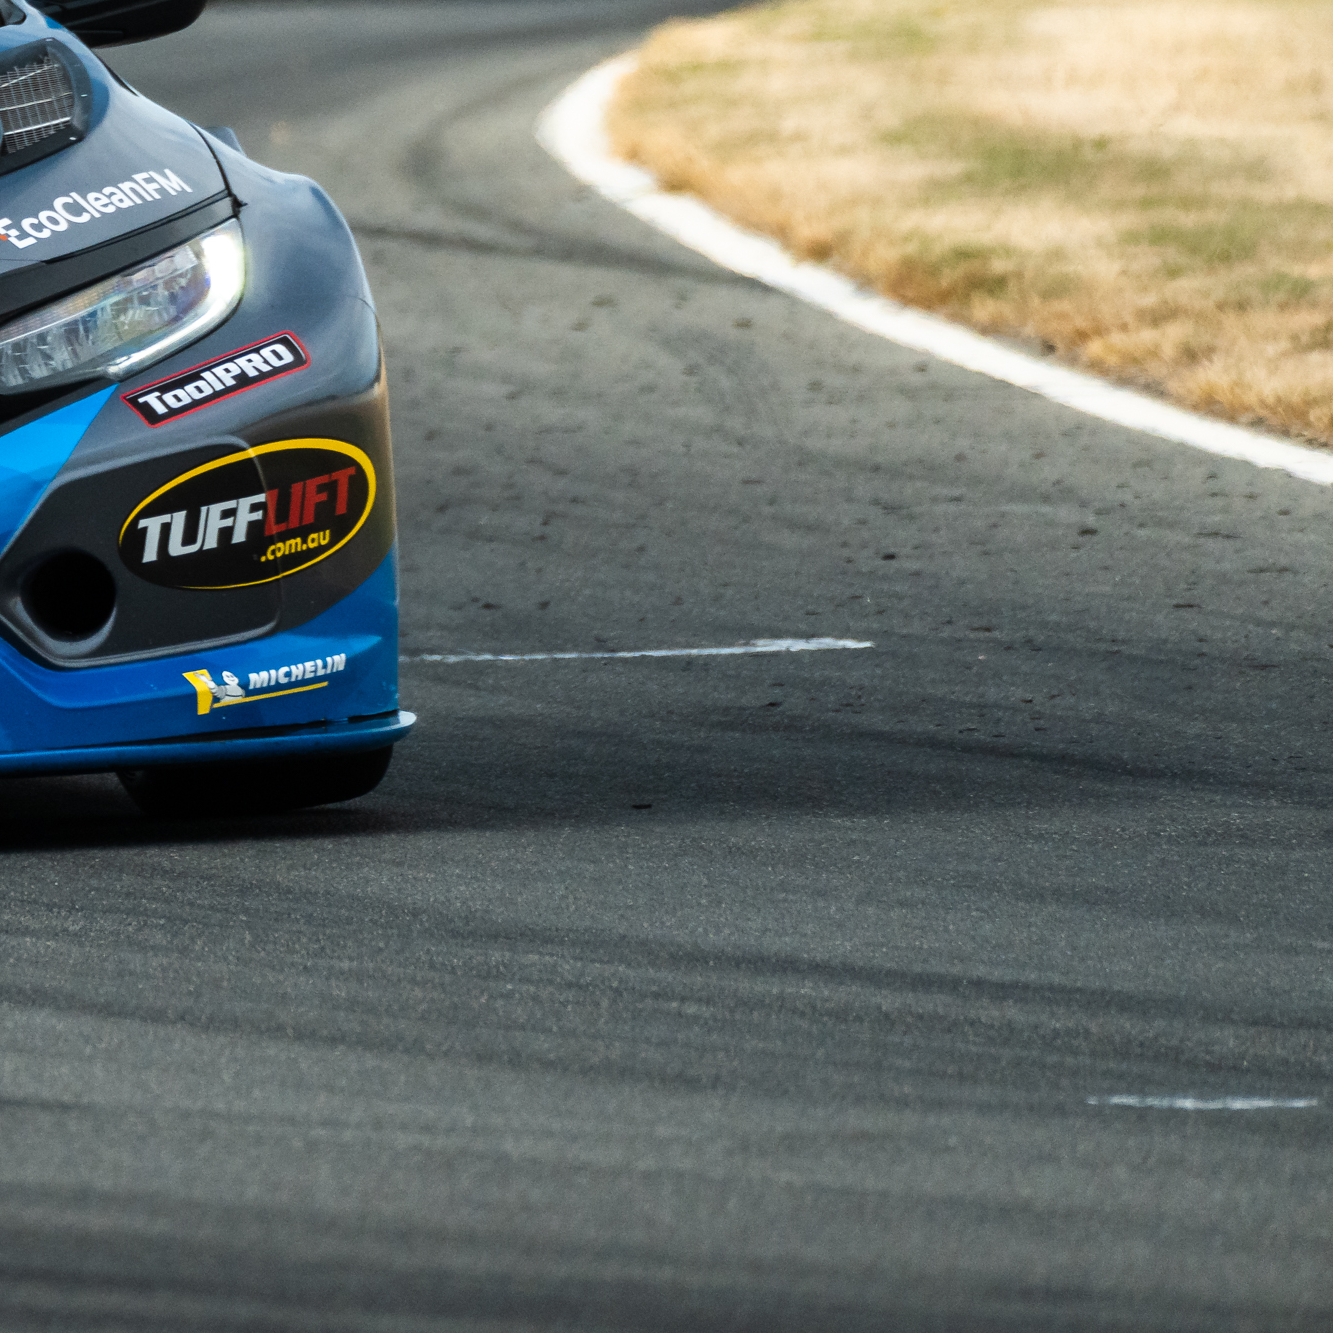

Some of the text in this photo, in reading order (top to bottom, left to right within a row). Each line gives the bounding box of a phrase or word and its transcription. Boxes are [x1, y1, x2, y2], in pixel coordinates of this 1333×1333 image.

[137, 341, 295, 417] ToolPRO
[136, 466, 356, 564] TUFFLIFT
[260, 529, 331, 563] .com.au
[248, 653, 347, 690] MICHELIN
